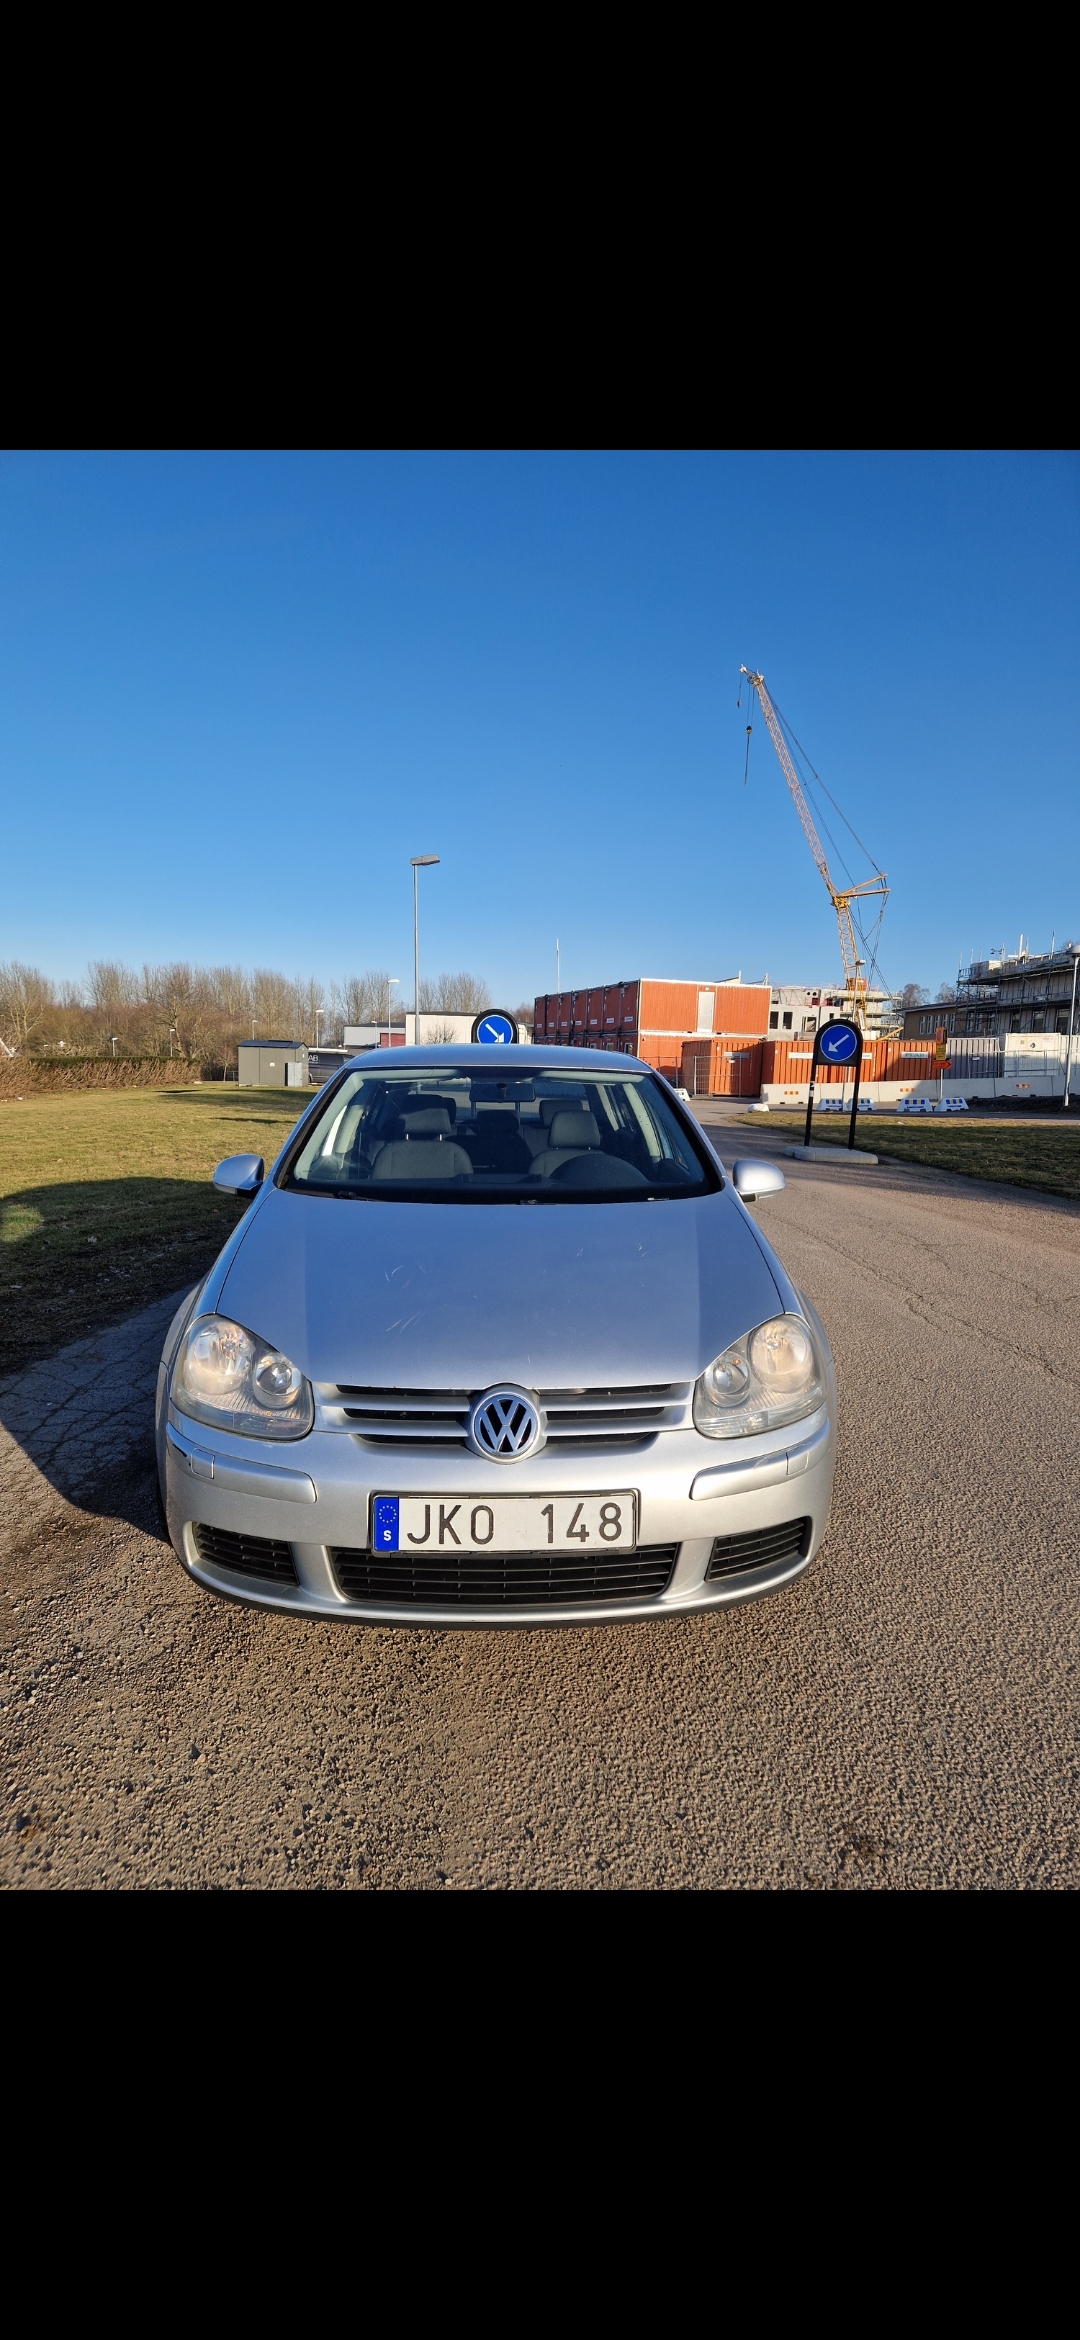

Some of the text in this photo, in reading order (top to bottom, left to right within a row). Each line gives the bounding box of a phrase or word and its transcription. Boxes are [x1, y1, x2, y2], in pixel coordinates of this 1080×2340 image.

[476, 1395, 536, 1457] VW
[383, 1529, 392, 1541] S
[406, 1502, 622, 1545] JKO 148
